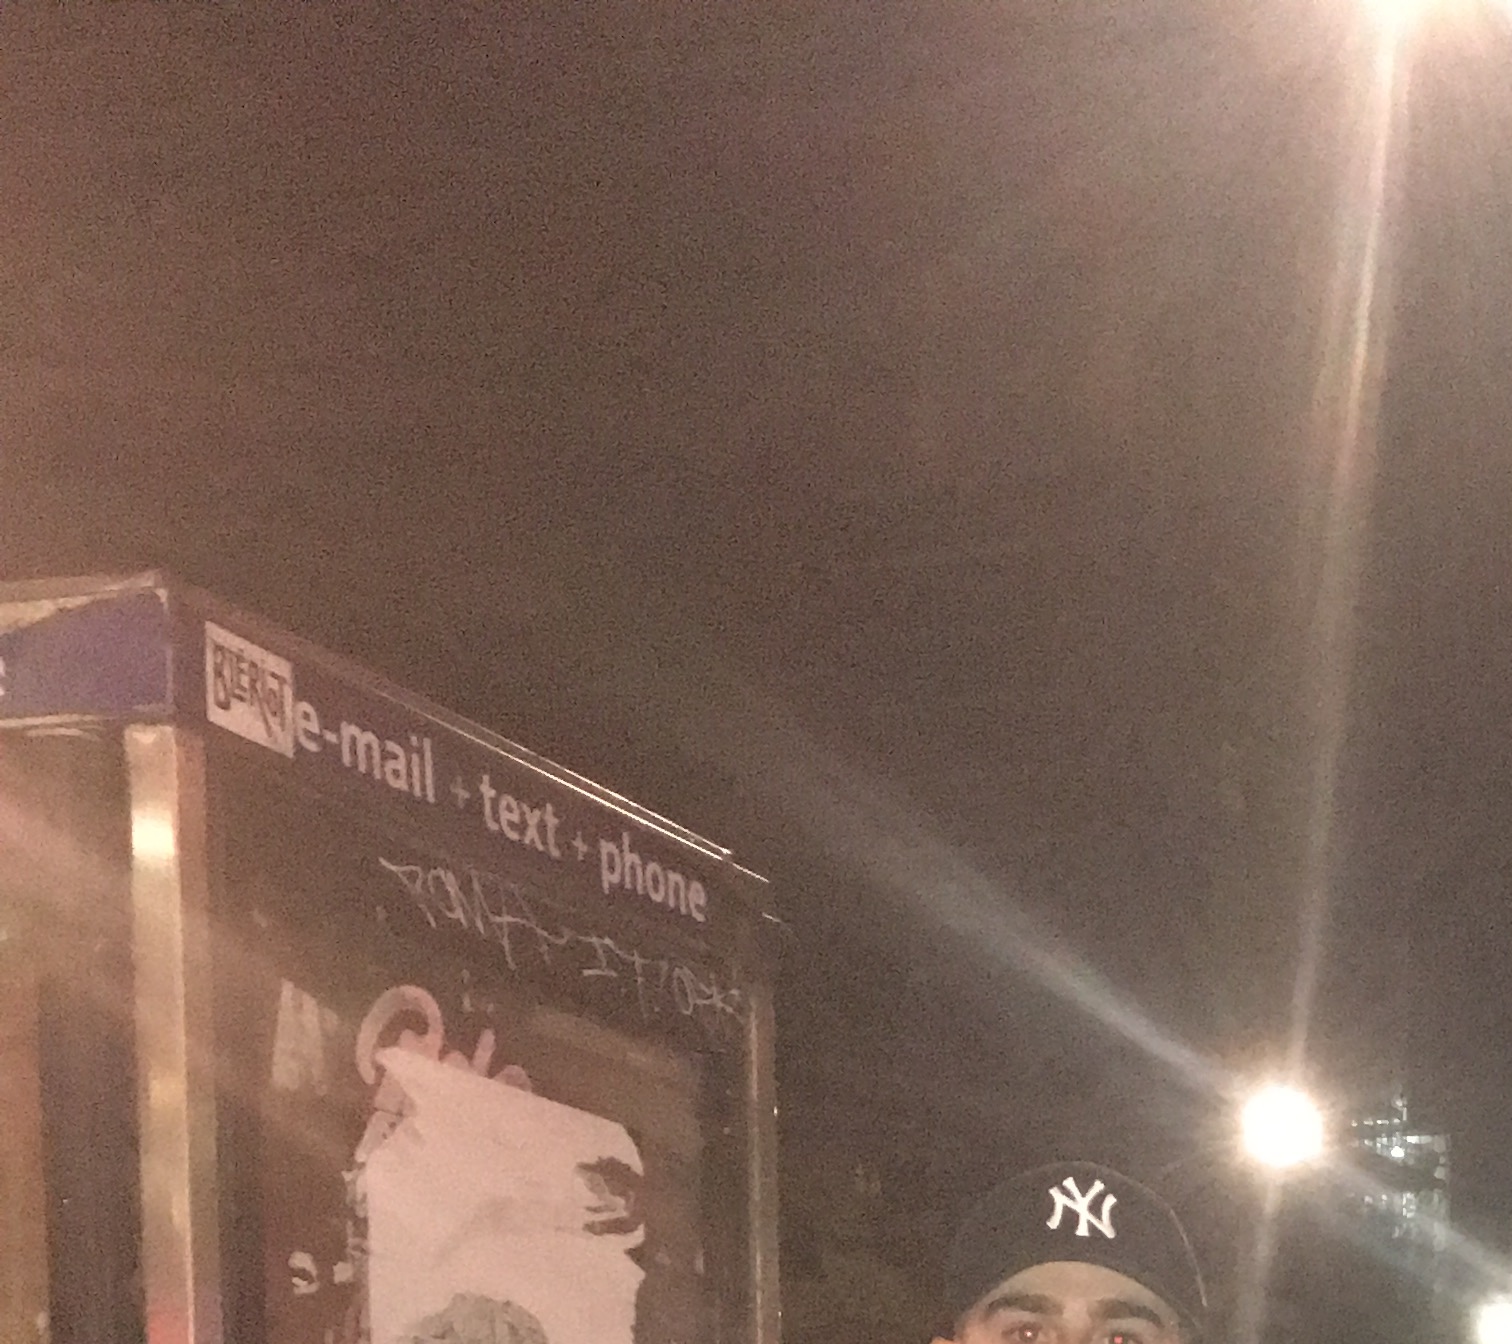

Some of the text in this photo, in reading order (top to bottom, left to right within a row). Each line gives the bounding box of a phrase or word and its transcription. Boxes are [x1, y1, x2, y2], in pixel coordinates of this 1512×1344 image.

[295, 700, 436, 804] e-mail
[479, 774, 562, 860] text
[599, 831, 708, 923] phone
[1046, 1176, 1118, 1239] NY
